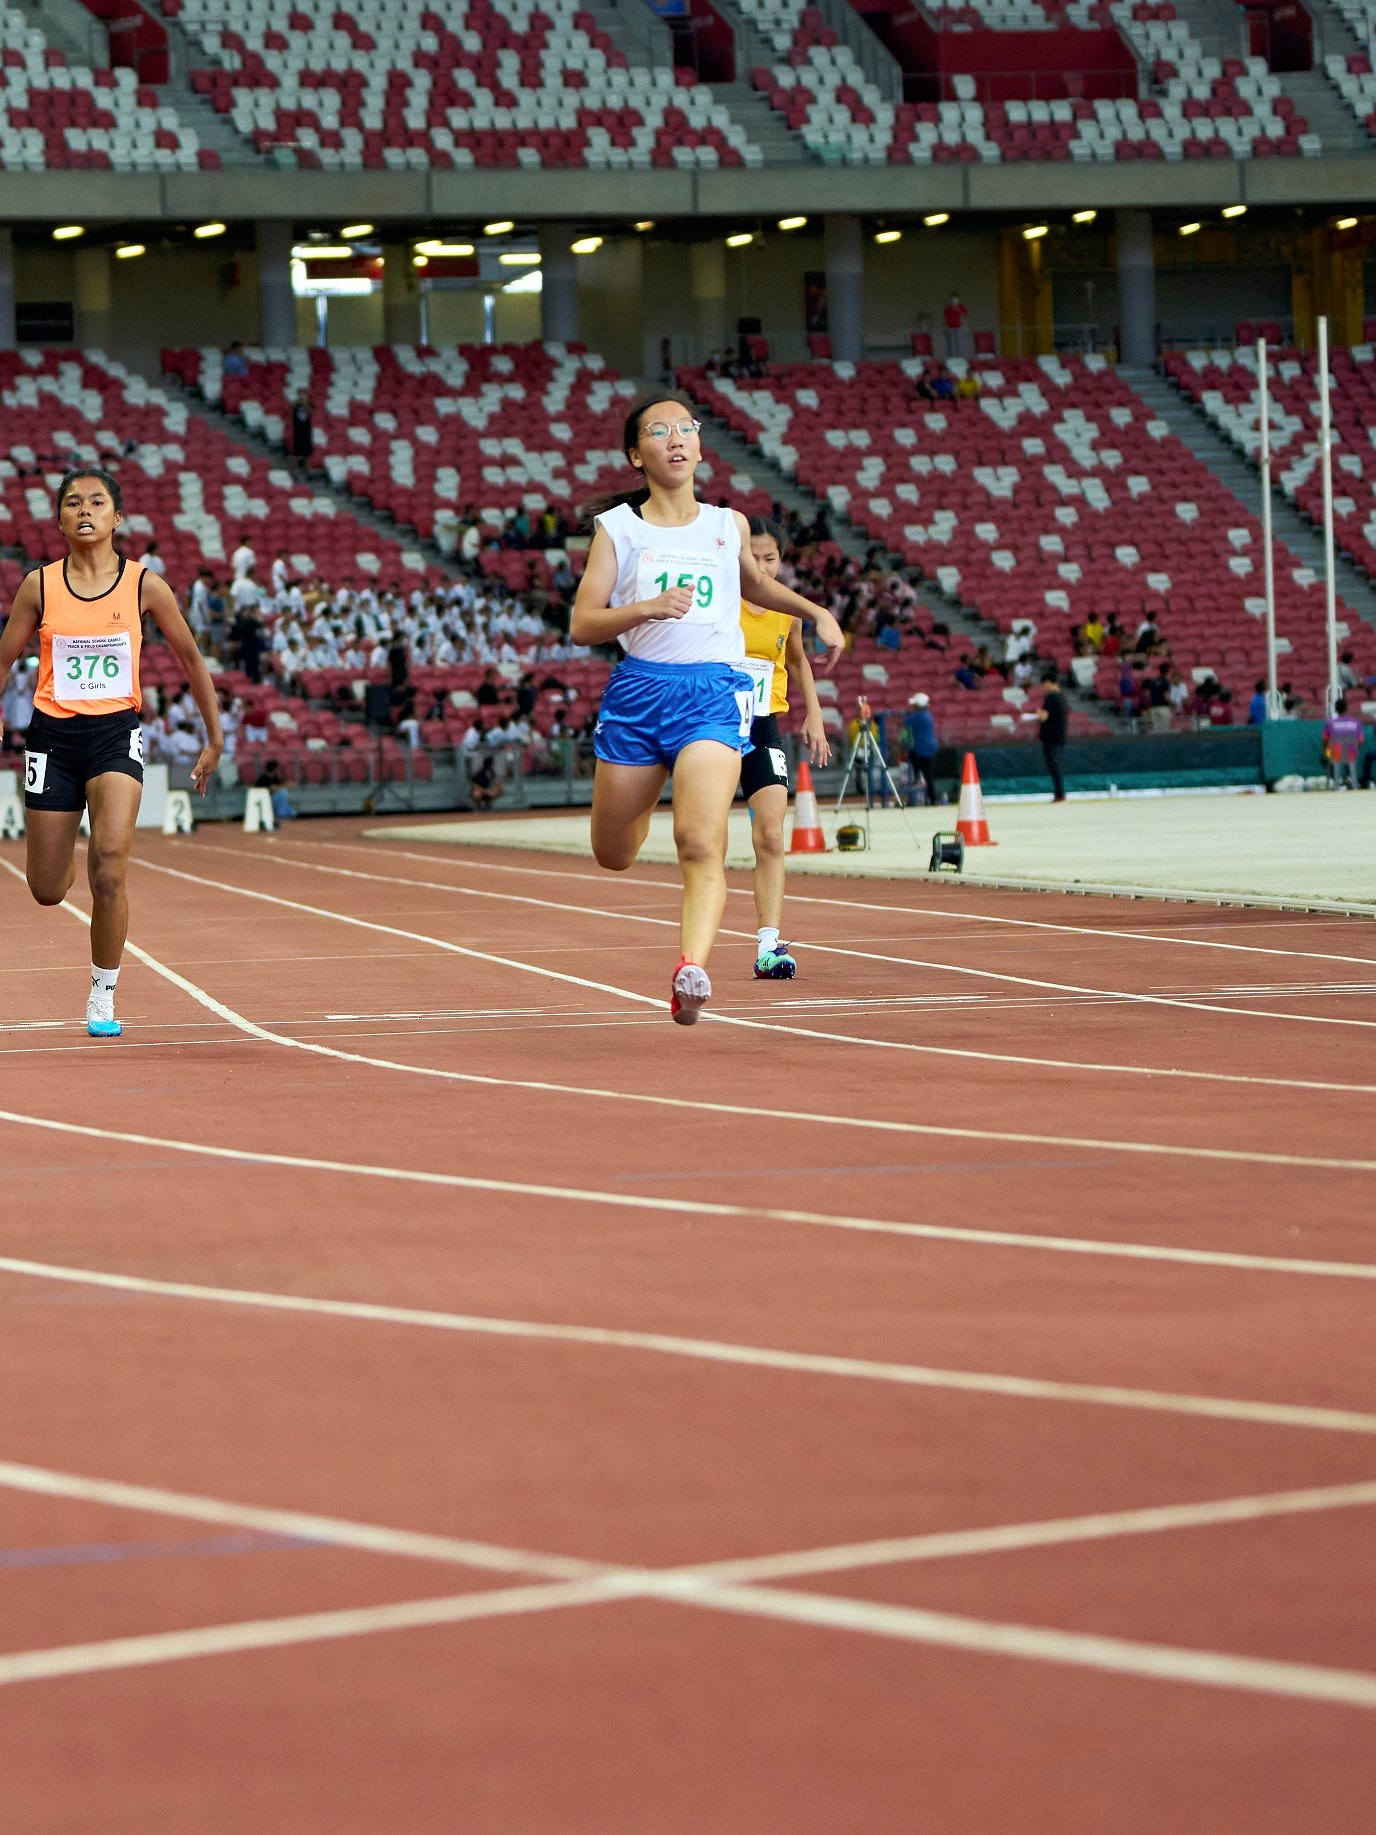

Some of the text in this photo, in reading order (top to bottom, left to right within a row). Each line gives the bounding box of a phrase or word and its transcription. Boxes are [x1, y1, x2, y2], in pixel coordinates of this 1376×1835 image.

[655, 571, 713, 608] 159
[66, 655, 119, 680] 376
[88, 682, 106, 690] Girls
[28, 756, 37, 786] 5
[173, 799, 184, 822] 2
